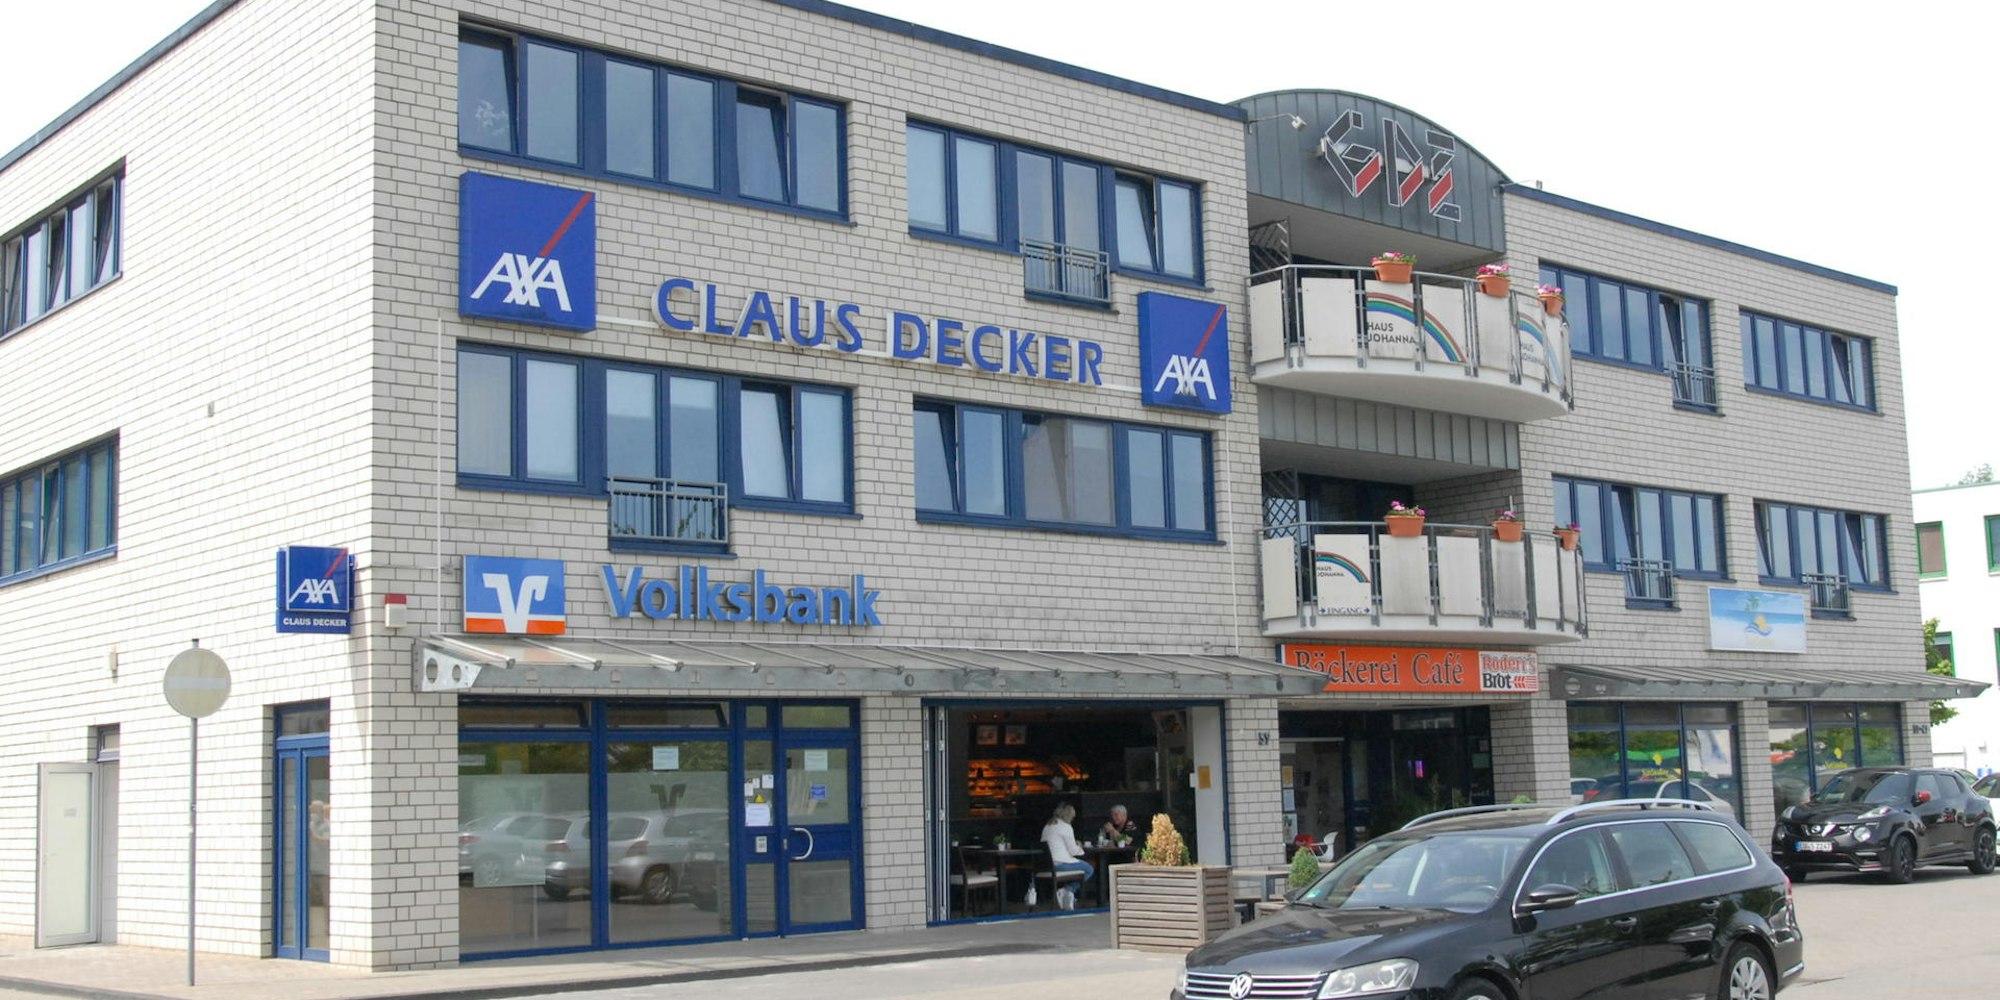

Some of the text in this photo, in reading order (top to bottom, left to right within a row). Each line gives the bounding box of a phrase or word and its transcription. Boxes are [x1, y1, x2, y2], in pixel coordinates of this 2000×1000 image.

[470, 252, 572, 312] AXA
[652, 277, 1103, 386] CLAUS DECKER
[1367, 321, 1394, 332] HAUS
[1367, 333, 1417, 345] JOHANNA
[1154, 353, 1217, 400] AXA
[289, 578, 340, 604] AXA
[602, 563, 882, 627] Volksbank
[283, 617, 347, 627] CLAUS DECKER
[1294, 649, 1464, 685] Bäckerei Café
[1482, 672, 1512, 689] Brot
